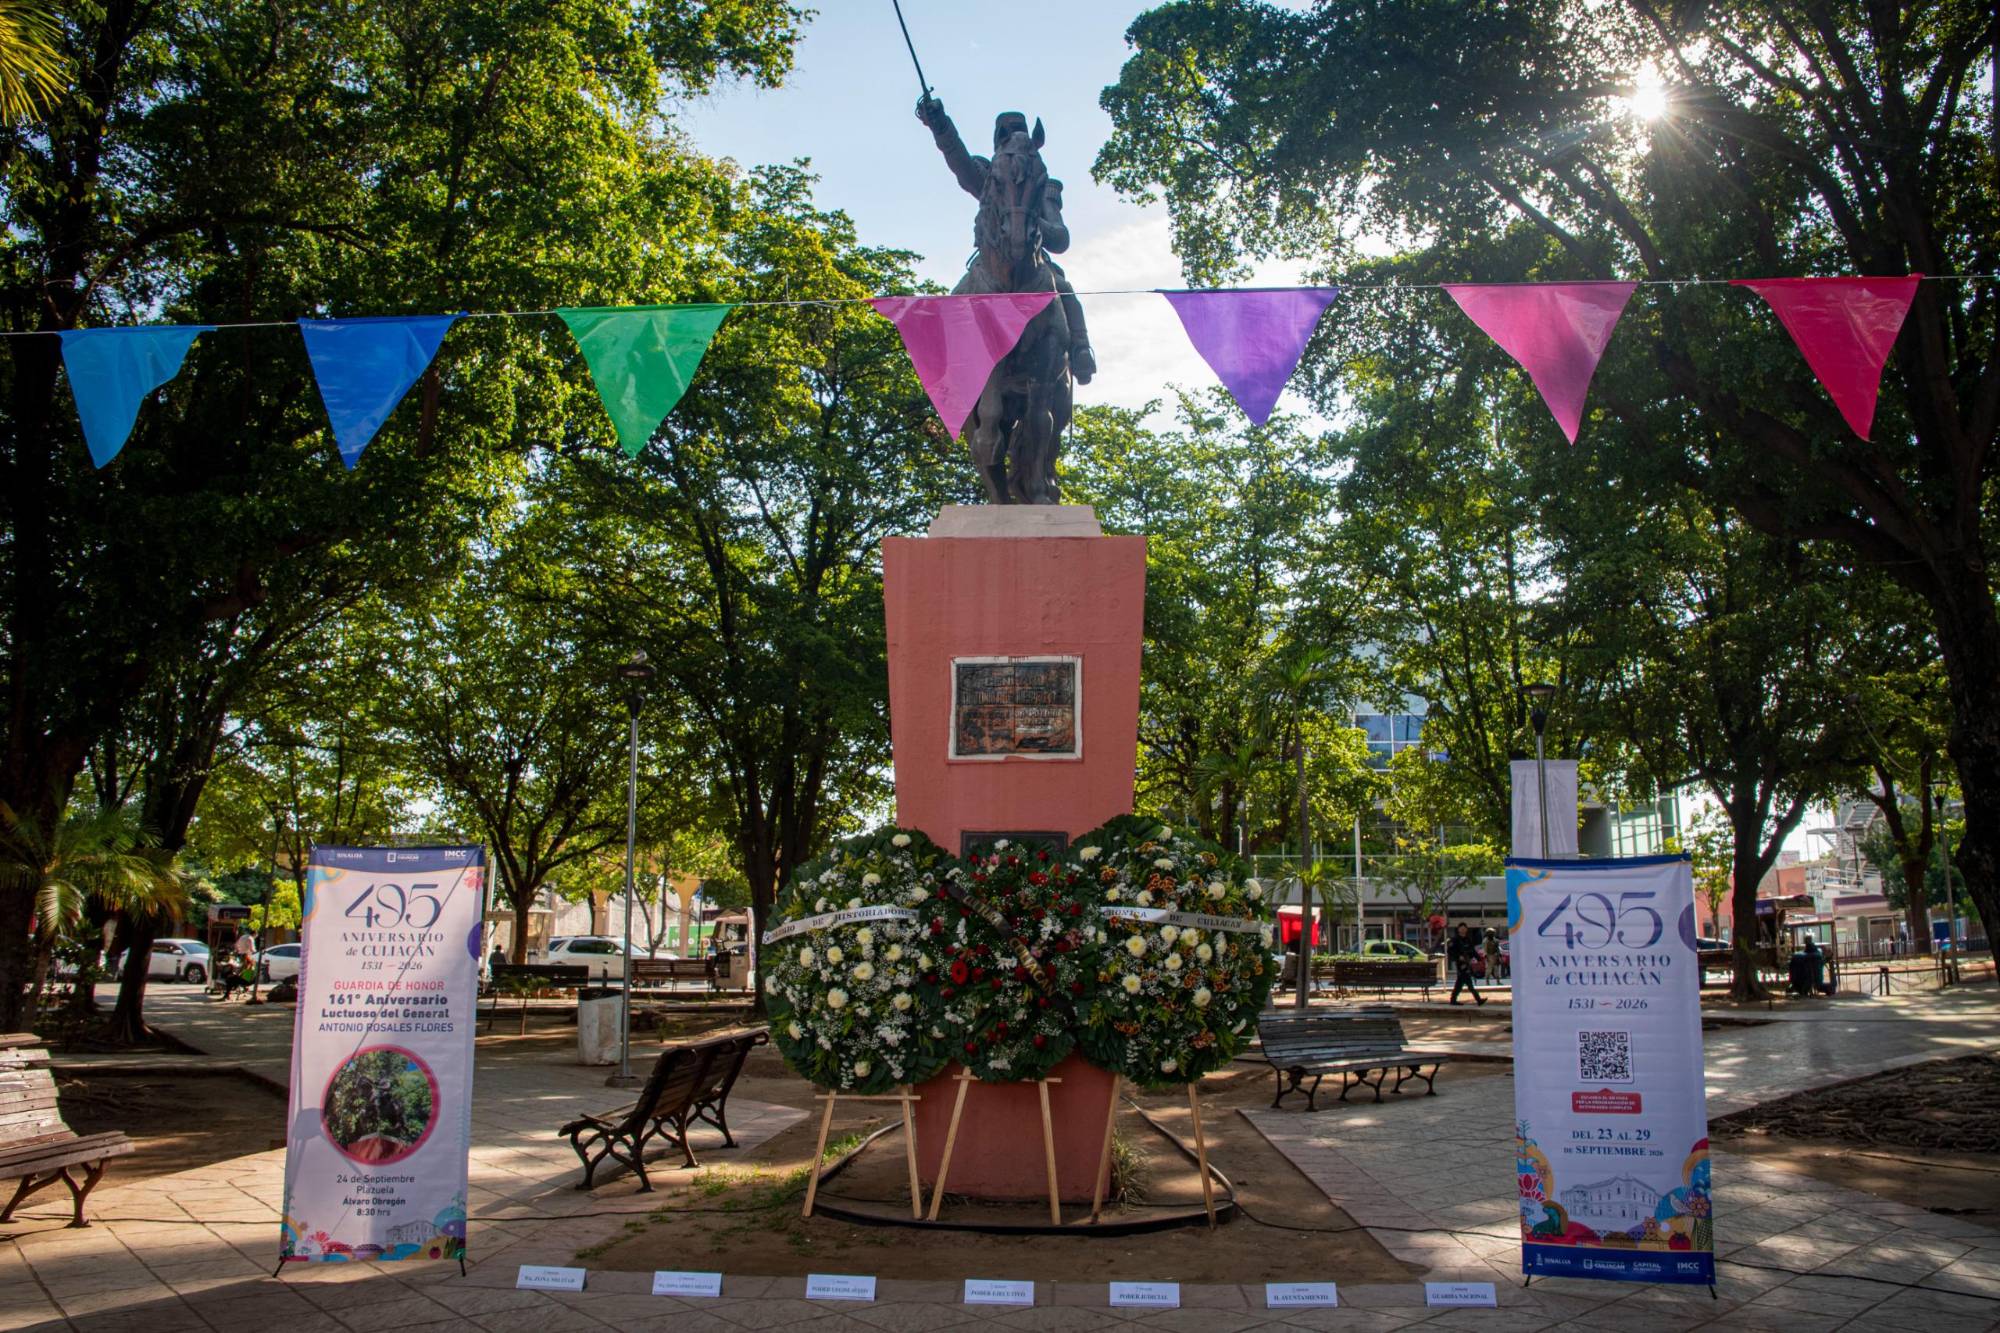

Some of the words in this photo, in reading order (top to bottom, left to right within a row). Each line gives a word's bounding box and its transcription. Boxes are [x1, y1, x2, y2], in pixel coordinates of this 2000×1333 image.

[345, 883, 441, 928] 495
[1538, 891, 1663, 949] 495
[341, 932, 444, 942] ANIVERSARIO
[345, 947, 358, 956] de
[361, 961, 383, 970] 1531
[398, 961, 423, 970] 2026
[1536, 955, 1671, 967] ANIVERSARIO
[1545, 974, 1560, 985] de
[1566, 968, 1661, 985] CULIACÁN
[334, 981, 384, 990] GUARDIA
[387, 981, 401, 990] DE
[406, 981, 445, 990] HONOR
[329, 993, 361, 1005] 161°
[365, 994, 448, 1005] Aniversario
[1568, 998, 1595, 1009] 1531
[1616, 998, 1648, 1009] 2026
[322, 1008, 377, 1018] Luctuoso
[380, 1008, 399, 1018] del
[402, 1008, 450, 1018] General
[319, 1022, 363, 1032] ANTONIO
[366, 1022, 412, 1033] ROSALES
[414, 1022, 454, 1033] FLORES
[1572, 1130, 1594, 1139] DEL
[1598, 1128, 1613, 1140] 23
[1616, 1131, 1632, 1140] AL
[1635, 1128, 1651, 1141] 29
[1575, 1145, 1647, 1156] SEPTIEMBRE
[336, 1174, 348, 1183] 24
[350, 1174, 361, 1183] de
[363, 1174, 416, 1184] Septiembre
[356, 1186, 395, 1194] Plazuela
[372, 1197, 406, 1206] Obregón
[356, 1208, 376, 1216] 8:30
[377, 1208, 391, 1216] hrs
